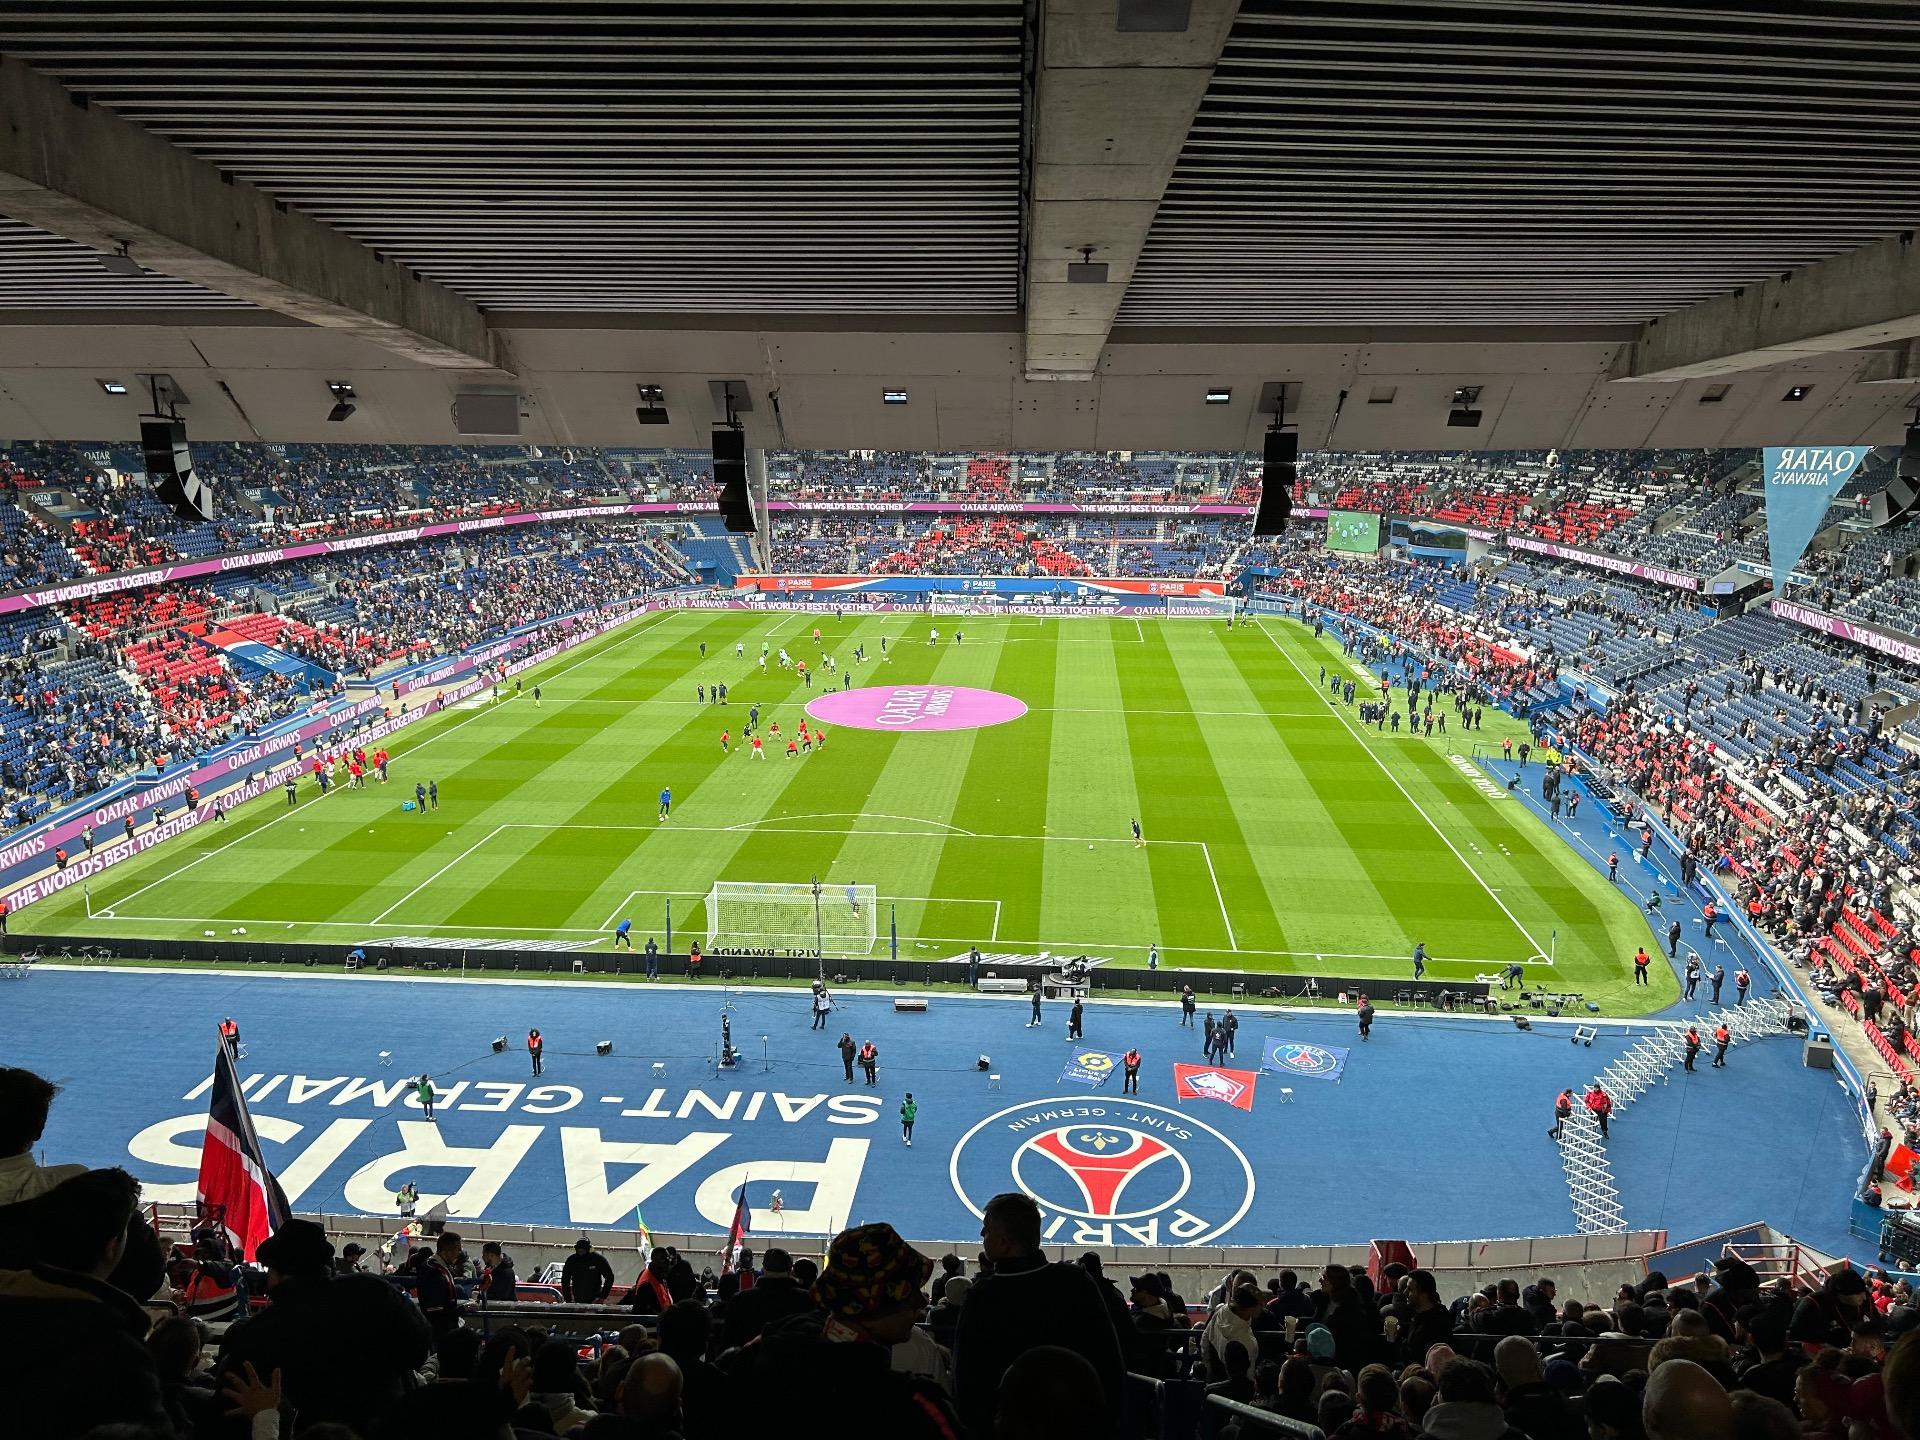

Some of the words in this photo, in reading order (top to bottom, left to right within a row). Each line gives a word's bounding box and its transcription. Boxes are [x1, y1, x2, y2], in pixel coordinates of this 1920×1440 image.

[677, 502, 704, 511] QATAR
[797, 502, 810, 510] THE
[866, 503, 904, 511] TOGETHER
[960, 503, 987, 511] QATAR
[989, 503, 1024, 512] AIRWAYS
[1291, 508, 1311, 517] WAYS
[459, 519, 480, 531] QATAR
[1507, 536, 1526, 548] QATAR
[222, 552, 250, 570] QATAR
[250, 550, 283, 566] AIRWAYS
[36, 590, 57, 605] THE
[56, 582, 97, 601] WORLD'S
[121, 570, 165, 589] TOGETHER
[1160, 583, 1184, 591] PARIS
[1643, 567, 1666, 583] QATAR
[1666, 571, 1696, 589] AIRWAYS
[659, 600, 688, 610] QATAR
[691, 600, 730, 609] AIRWAYS
[749, 601, 766, 610] THE
[767, 602, 805, 611] WORLD'S
[830, 602, 874, 612] TOGETHER
[893, 603, 925, 612] QATAR
[928, 603, 968, 612] AIRWAYS
[1069, 606, 1114, 615] TOGETHER
[1134, 606, 1166, 615] QATAR
[1169, 607, 1211, 615] AIRWAYS
[1773, 600, 1799, 620] QATAR
[1799, 608, 1834, 633] AIRWAYS
[1853, 628, 1870, 645] THE
[1869, 632, 1905, 659] WORLD'S
[1904, 643, 1920, 665] BES
[408, 673, 430, 691] QATAR
[460, 678, 484, 698] AIRWAYS
[329, 708, 356, 727] QATAR
[357, 694, 383, 717] AIRWAY
[390, 706, 425, 730] TOGETHER
[876, 689, 932, 725] QATAR
[228, 745, 262, 770] QATAR
[264, 729, 301, 755] AIRWAYS
[224, 783, 260, 810] QATAR
[263, 760, 304, 787] AIRWAYS
[95, 796, 140, 826] QATAR
[143, 774, 192, 806] AIRWAYS
[0, 834, 46, 868] RWAYS
[7, 888, 40, 913] THE
[39, 856, 104, 900] WORLD'S
[138, 810, 199, 850] TOGETHER
[621, 1088, 884, 1125] SAINT
[1007, 1106, 1107, 1133] GERMAIN
[1127, 1112, 1193, 1140] SAINT
[127, 1112, 871, 1235] PARIS
[1041, 1208, 1213, 1247] PARI
